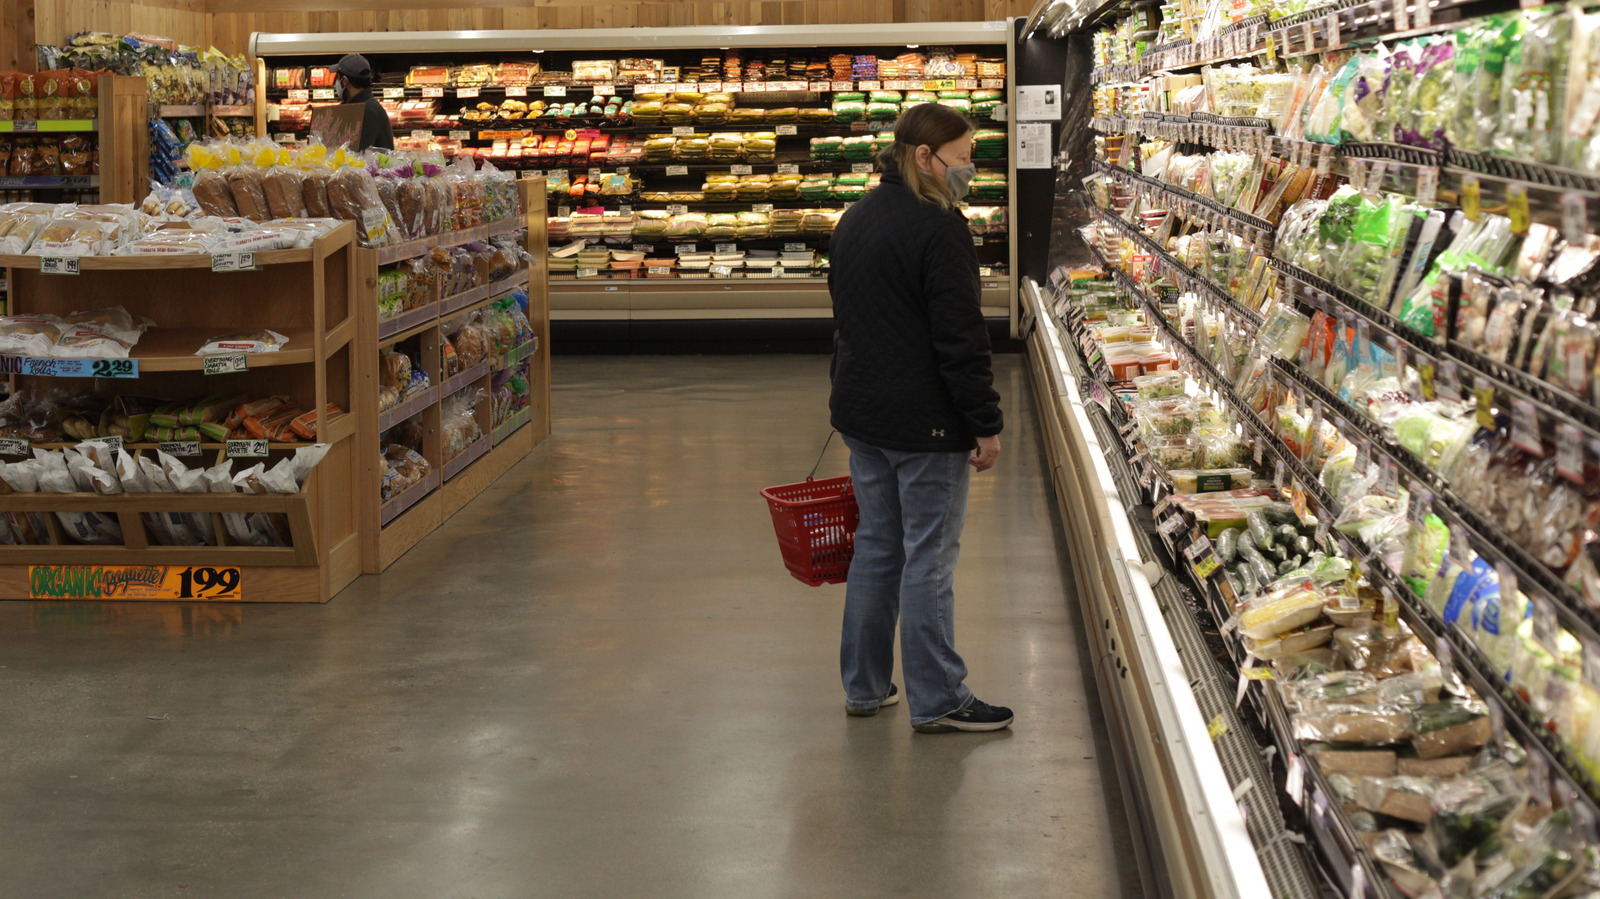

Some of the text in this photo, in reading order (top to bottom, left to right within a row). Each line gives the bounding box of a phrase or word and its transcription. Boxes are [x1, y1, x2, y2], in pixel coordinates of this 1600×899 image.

[24, 358, 57, 368] French
[30, 566, 104, 598] ORGANIC
[102, 566, 168, 596] Baguette!
